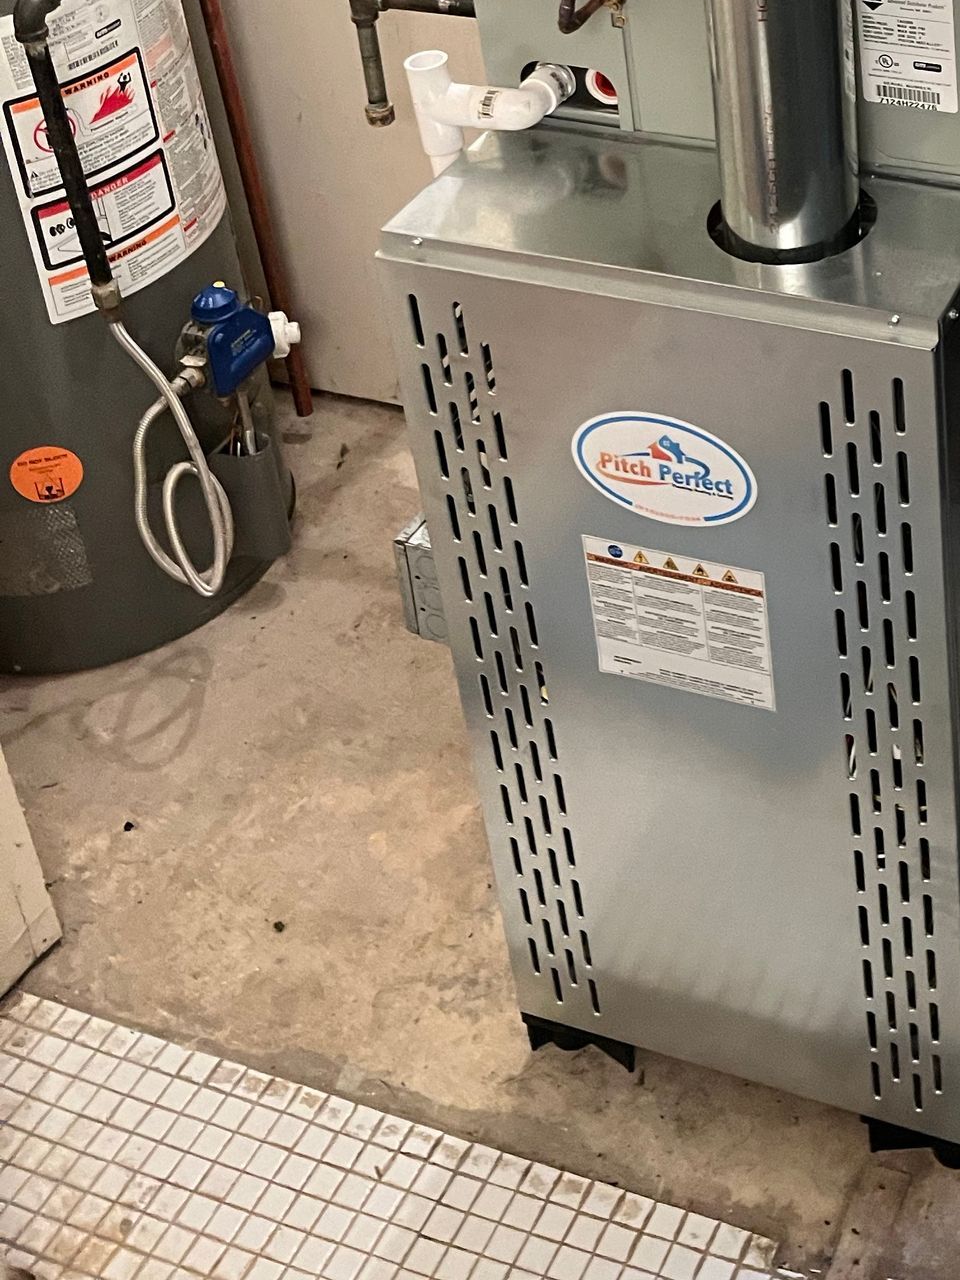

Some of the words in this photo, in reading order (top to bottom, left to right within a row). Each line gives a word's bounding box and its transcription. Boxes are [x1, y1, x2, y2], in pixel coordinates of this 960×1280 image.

[64, 71, 111, 96] WARNING
[90, 176, 130, 199] DANGER
[108, 240, 148, 263] WARNING
[599, 451, 652, 478] Pitch
[658, 463, 734, 495] Perfect
